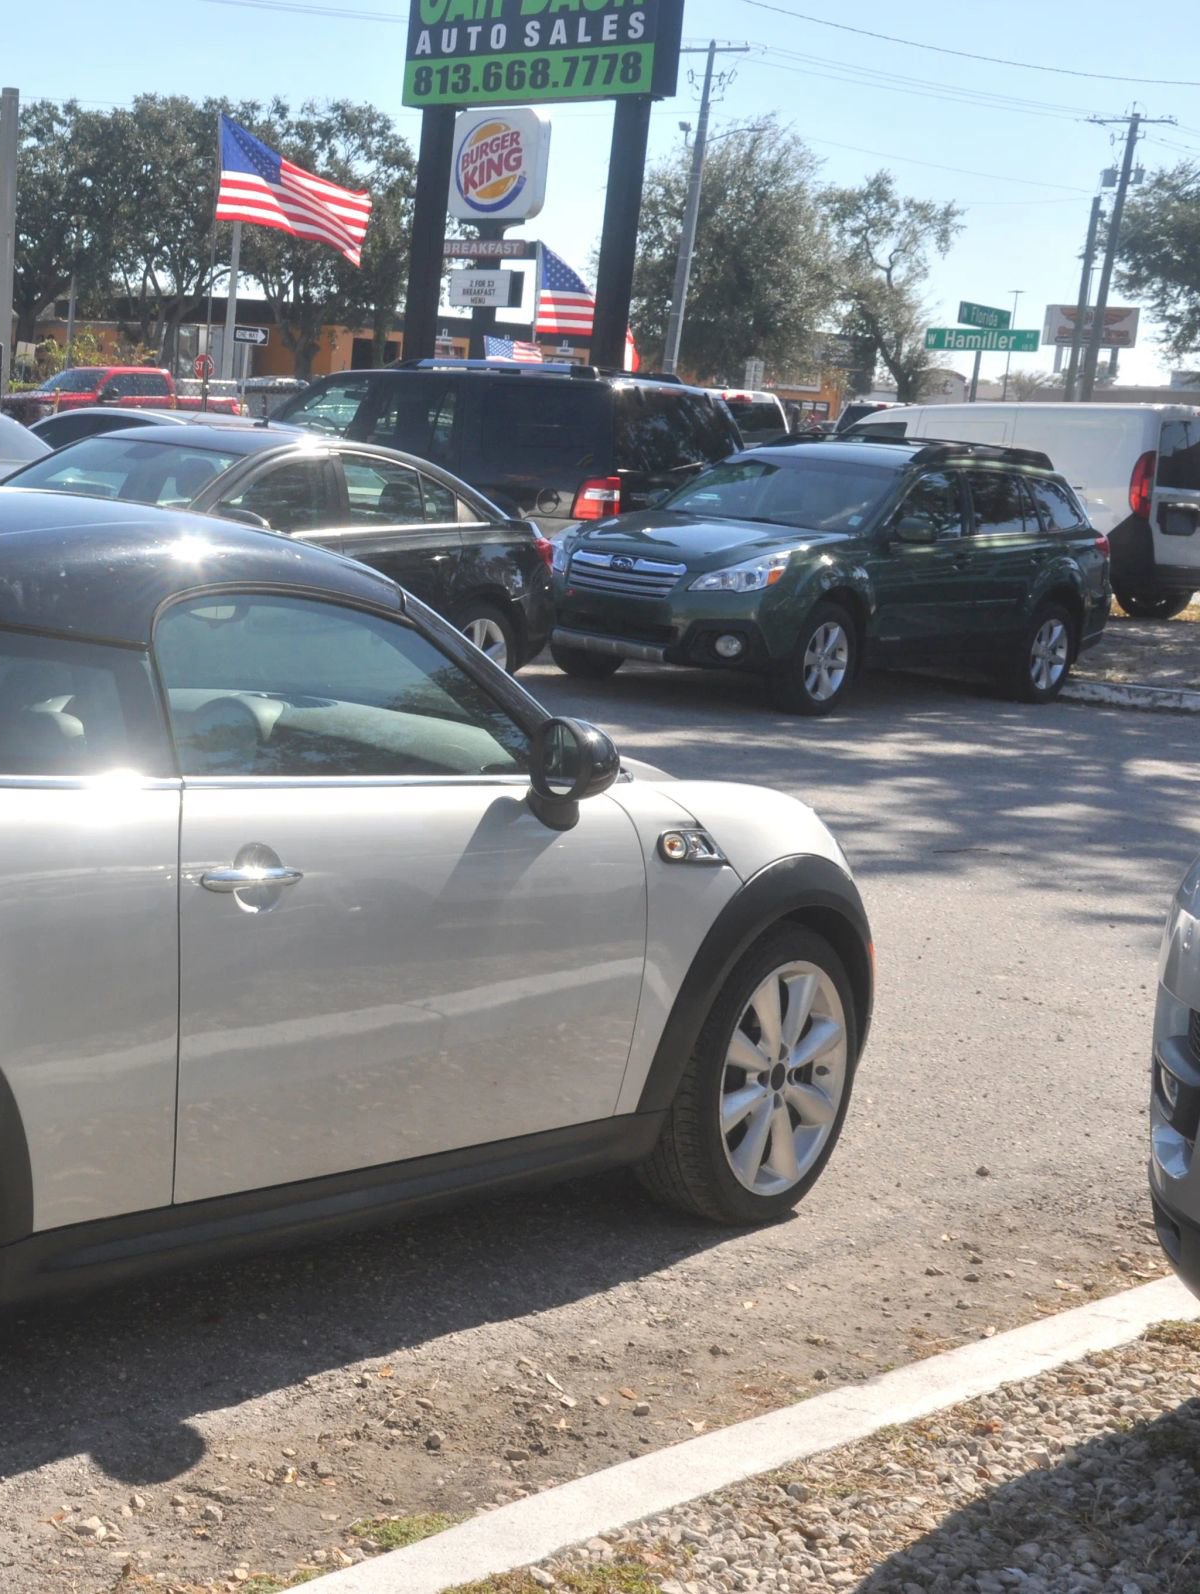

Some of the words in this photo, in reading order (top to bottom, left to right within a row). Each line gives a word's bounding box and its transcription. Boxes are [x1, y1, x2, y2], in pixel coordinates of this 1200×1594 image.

[415, 23, 507, 55] AUTO
[524, 11, 646, 47] SALES
[413, 51, 643, 96] 813.668.7778
[461, 130, 521, 172] BURGER
[463, 146, 523, 196] KING
[443, 242, 520, 255] BREAKFAST
[462, 288, 496, 296] BREAKFAST
[474, 280, 486, 288] FOR
[470, 297, 486, 305] MENU
[971, 306, 999, 327] Florida
[927, 333, 937, 345] W
[944, 330, 1017, 349] Hamiller
